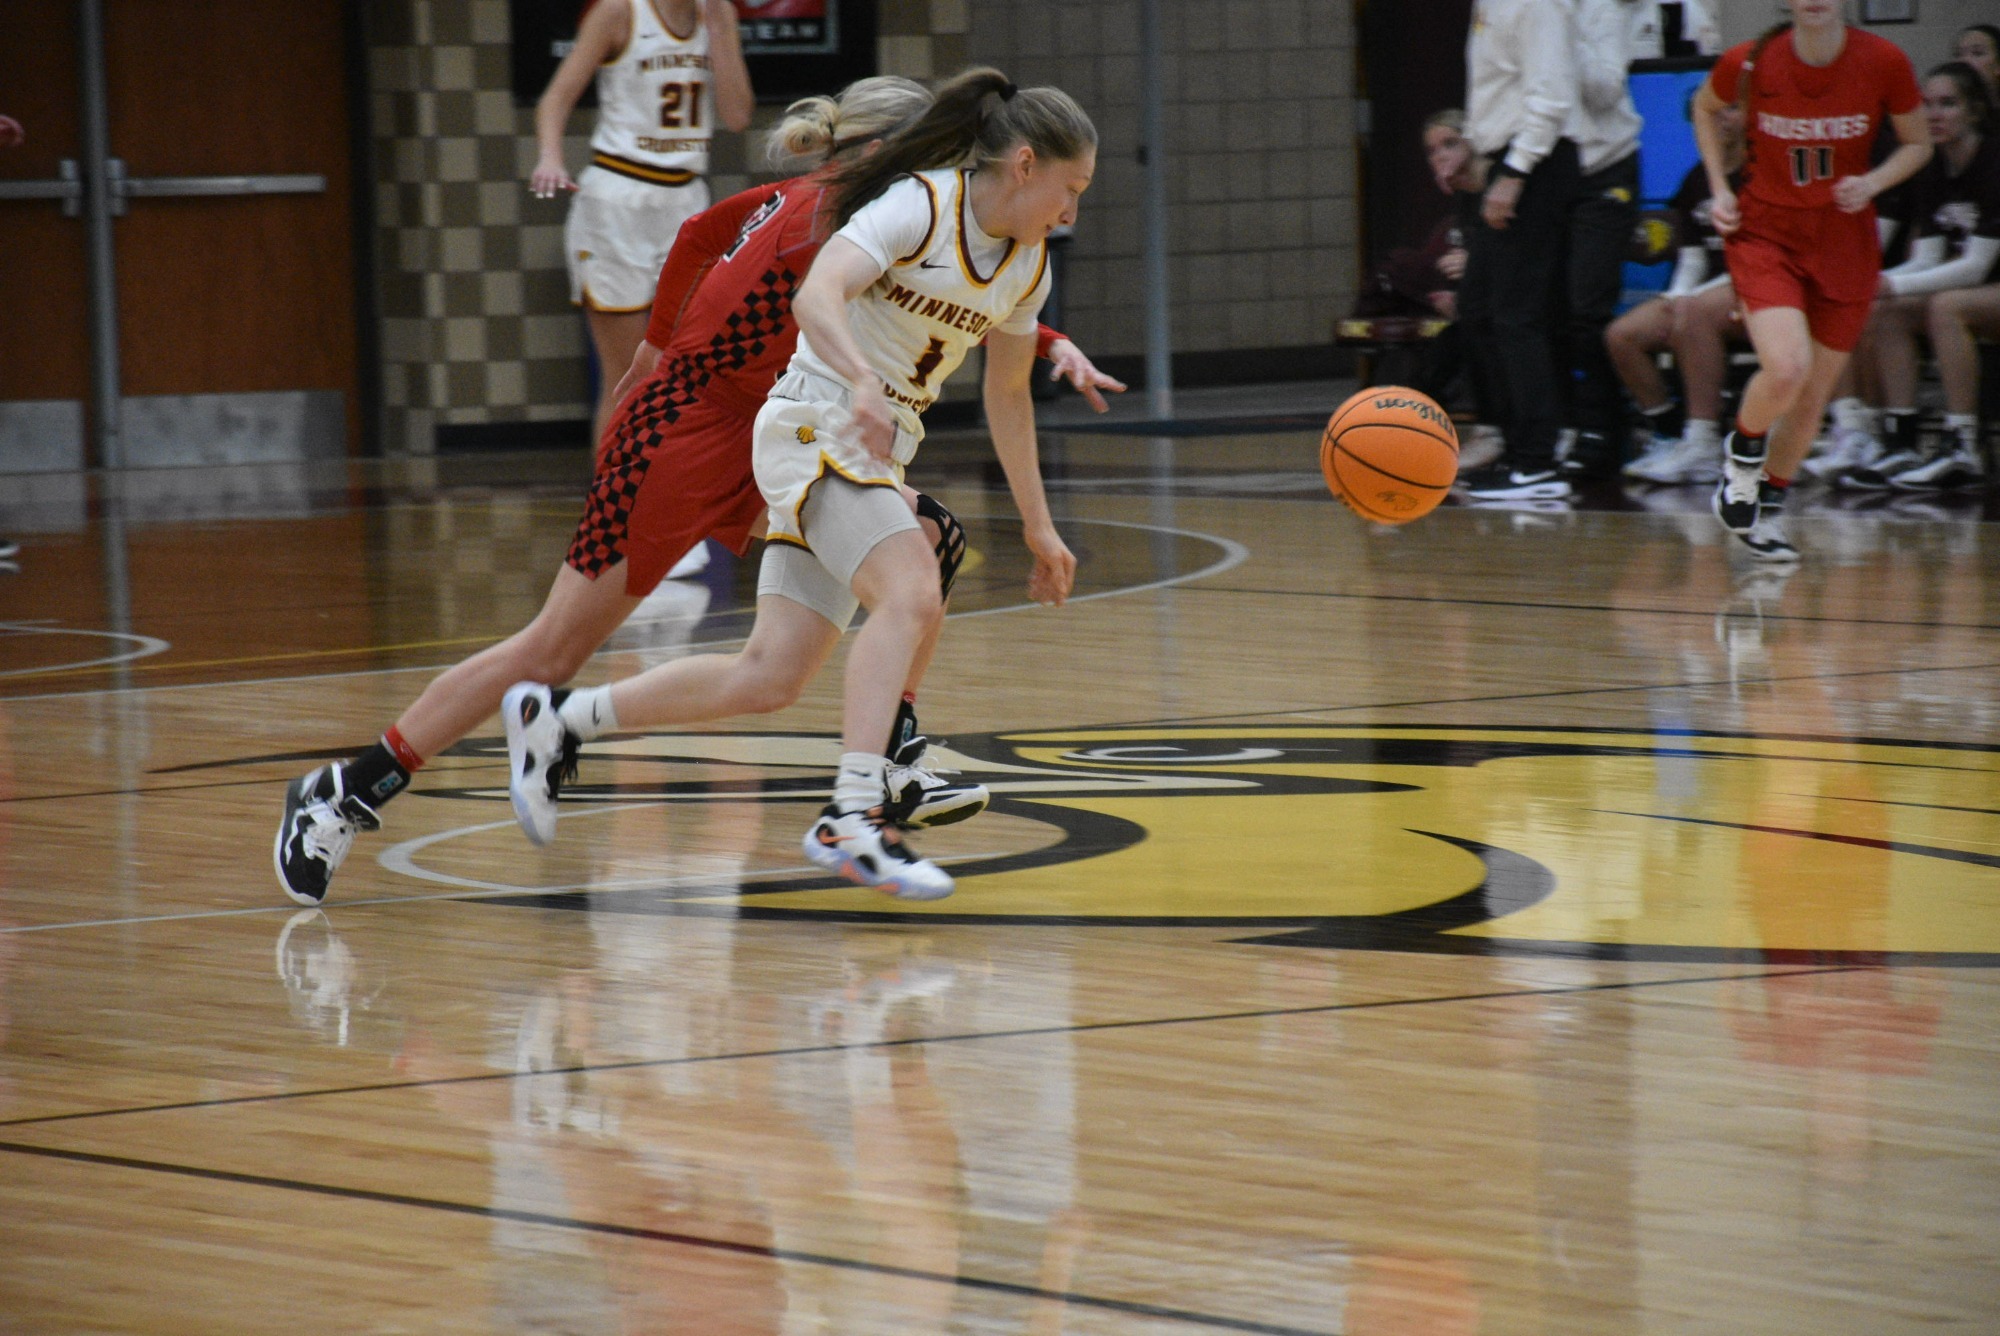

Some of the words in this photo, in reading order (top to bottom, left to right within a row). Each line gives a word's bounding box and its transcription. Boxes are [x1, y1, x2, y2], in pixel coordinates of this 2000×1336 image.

[660, 81, 704, 128] 21
[1757, 111, 1870, 141] HUSKIES
[1787, 145, 1836, 187] 11
[908, 333, 948, 389] 1
